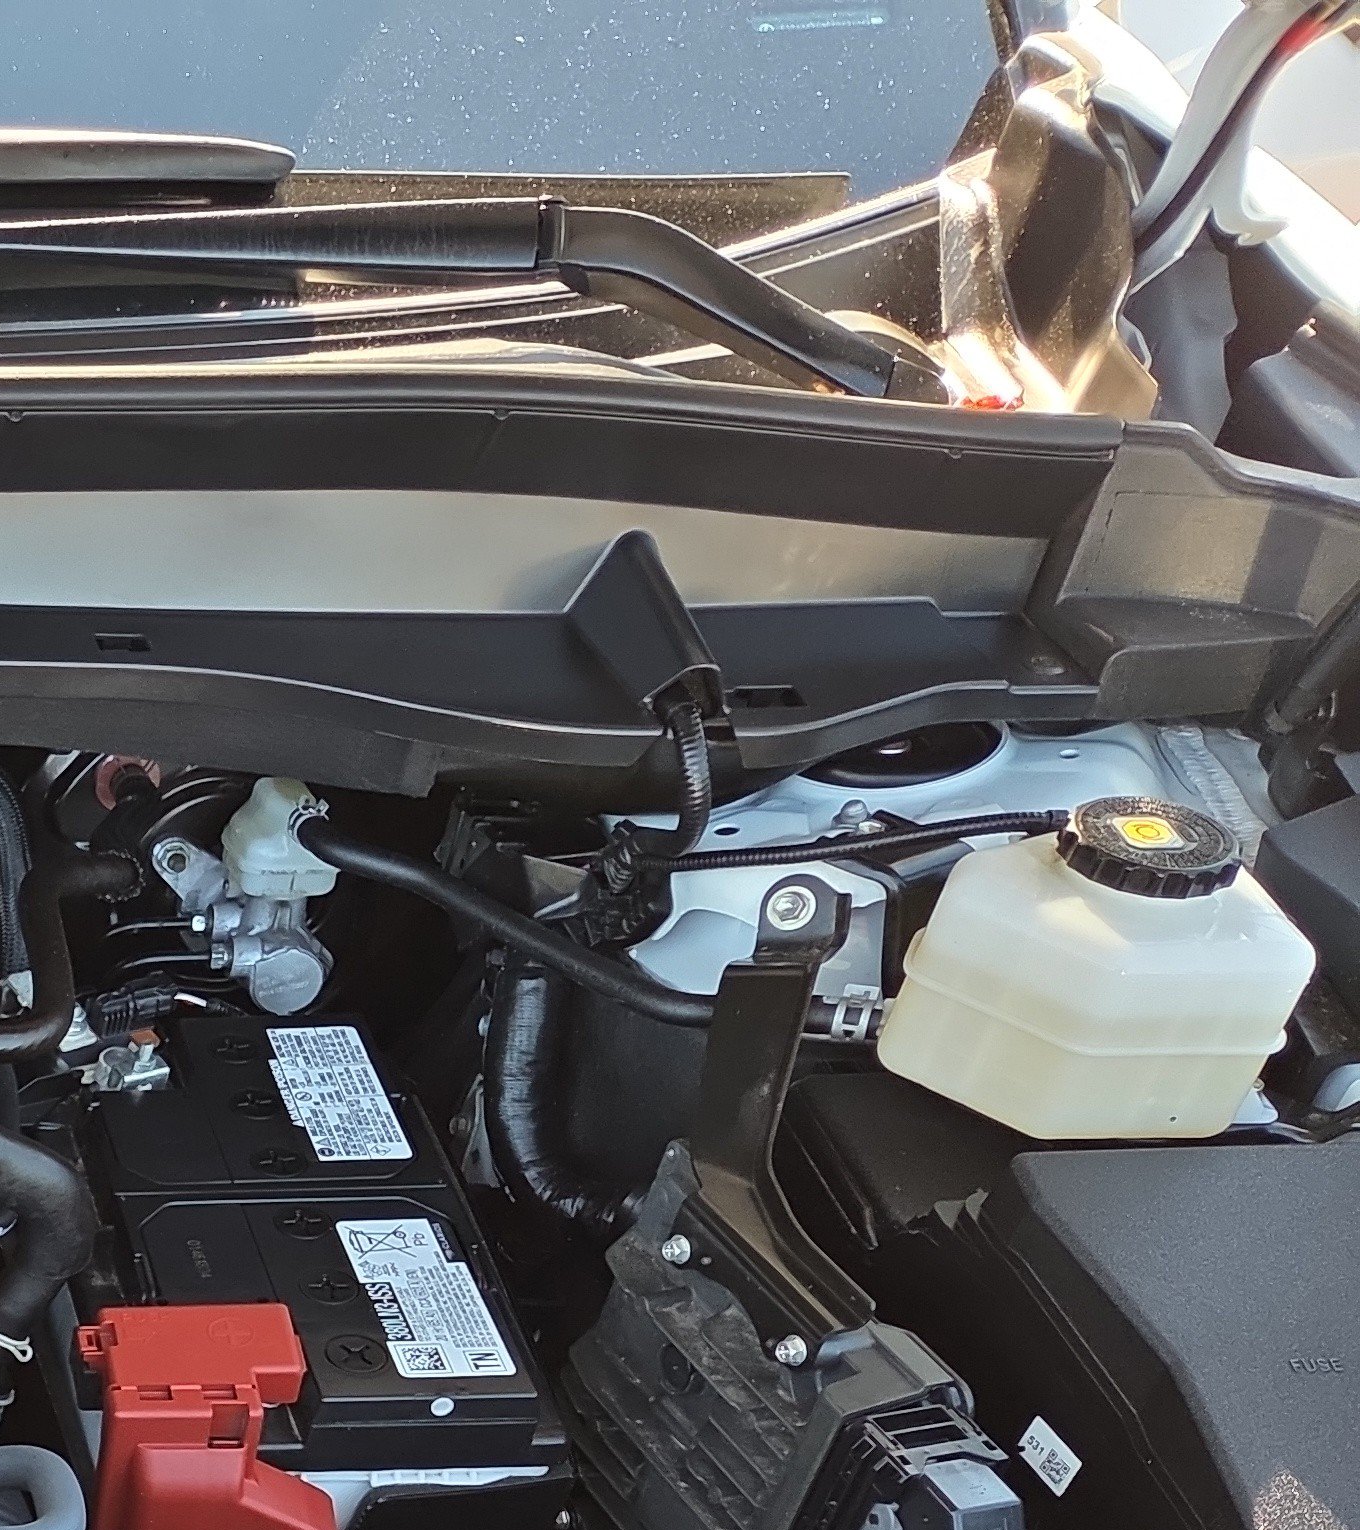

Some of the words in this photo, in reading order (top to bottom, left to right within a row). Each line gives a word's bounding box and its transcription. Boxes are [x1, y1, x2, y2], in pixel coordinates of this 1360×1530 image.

[413, 1233, 429, 1247] Pb
[471, 1350, 501, 1372] TN
[1289, 1357, 1344, 1374] FUSE
[1026, 1435, 1046, 1457] 531
